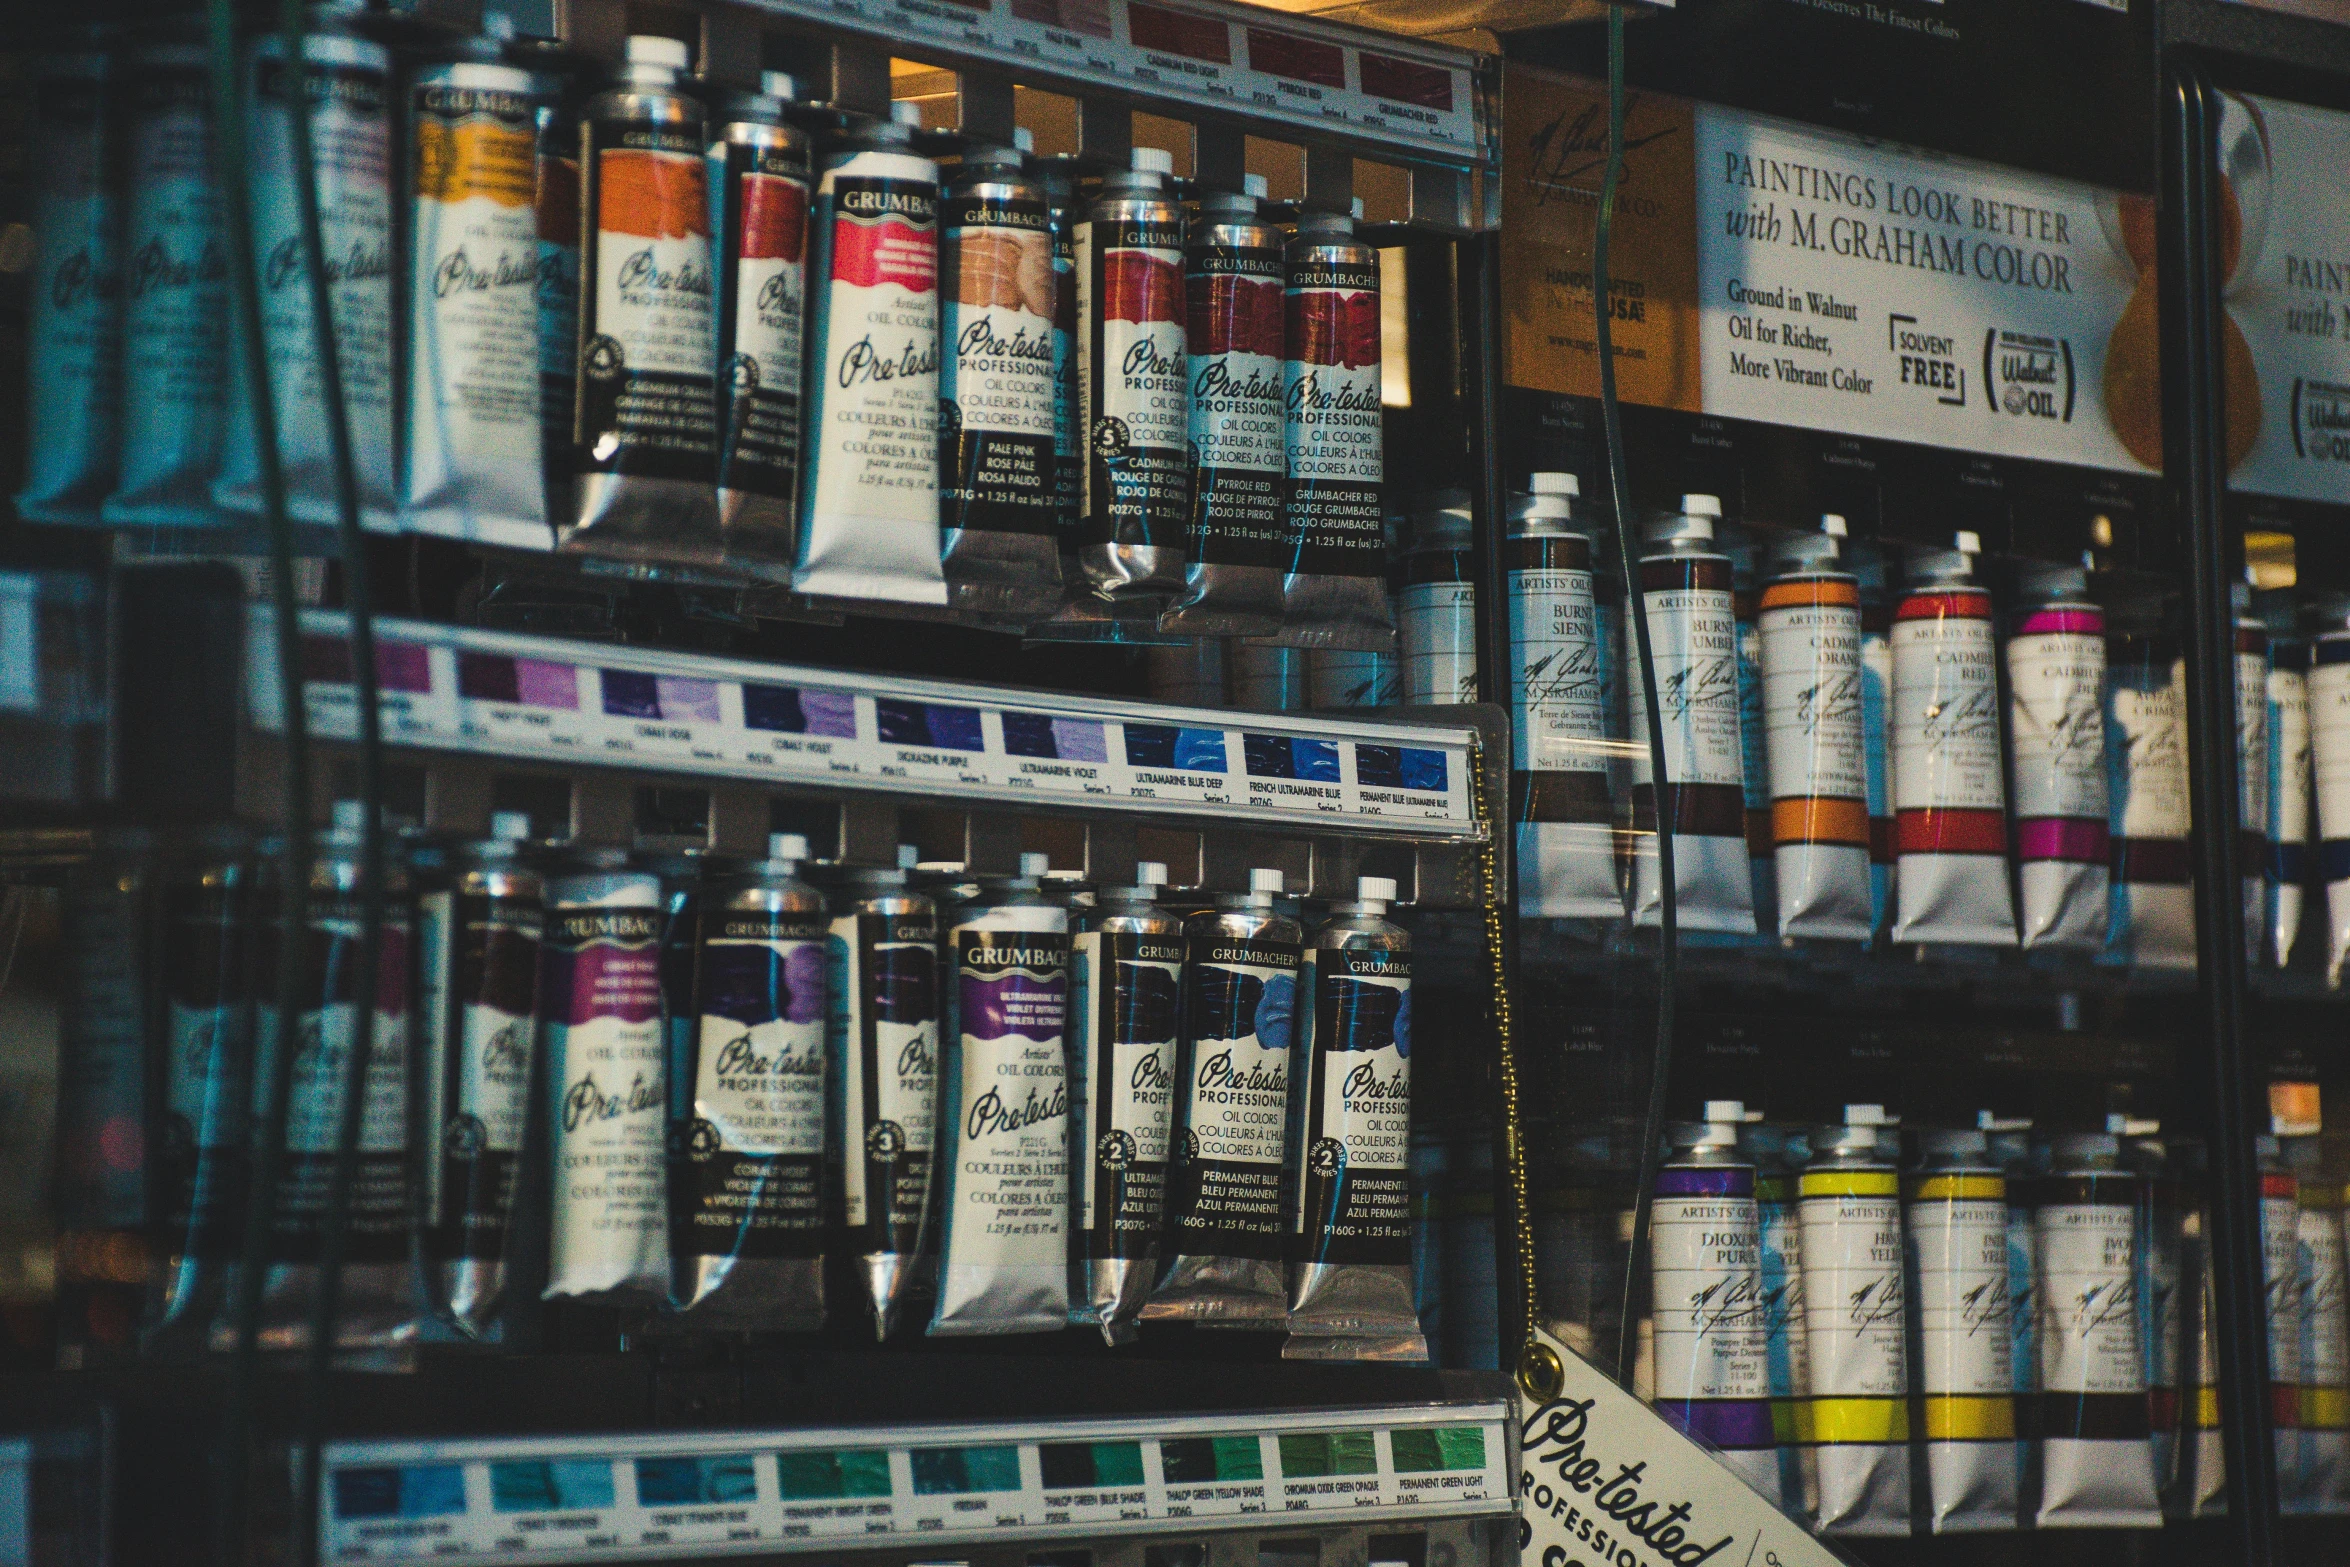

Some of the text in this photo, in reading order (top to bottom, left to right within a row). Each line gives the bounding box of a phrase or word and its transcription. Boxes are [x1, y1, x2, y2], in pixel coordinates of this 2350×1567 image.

[1864, 3, 1885, 24] The
[1924, 17, 1960, 40] Colors
[1725, 151, 2070, 244] PAINTINGS LOOK BETTER
[1725, 202, 1781, 242] with
[1974, 242, 2073, 294] COLOR
[1546, 267, 1646, 298] HANDCAFTED
[1727, 278, 1858, 321] Ground in Walnut
[1729, 315, 1833, 356] Oil for Richer,
[1900, 331, 1954, 355] SOLVENT
[1730, 351, 1873, 394] More Vibrant Color
[1900, 355, 1956, 390] FREE
[2002, 353, 2056, 384] Walnut
[985, 379, 1003, 391] OIL
[1286, 370, 1380, 411] Pre-tested
[2028, 390, 2057, 419] OIL
[1221, 418, 1277, 434] OIL COLORS
[1287, 411, 1380, 428] PROFESSIONAL
[1103, 432, 1114, 445] 5
[1198, 434, 1254, 447] COULEURS
[1312, 430, 1371, 444] OIL COLORS
[988, 443, 1035, 456] PALE PINK
[1289, 445, 1357, 459] COULEURS À
[986, 458, 1012, 469] ROSE
[1203, 450, 1252, 464] COLORES
[1254, 453, 1261, 464] A
[1294, 462, 1381, 476] COLORES A ÓLEO
[978, 472, 1005, 484] ROSA
[1112, 472, 1165, 483] ROUGE DE
[1217, 478, 1271, 491] PYRROLE RED
[1117, 486, 1162, 498] ROJO DE
[1296, 490, 1378, 503] GRUMBACHER RED
[1200, 492, 1280, 507] ROUGE DE PYRROLE
[1208, 506, 1275, 521] ROJO DE PIRROL
[1287, 504, 1381, 516] ROUGE GRUMBACHER
[1290, 517, 1379, 530] ROJO GRUMBACHER
[1516, 577, 1568, 590] ARTISTS'
[1962, 668, 1987, 681] RED
[1538, 709, 1558, 719] Terre
[1560, 709, 1569, 719] de
[1537, 757, 1552, 768] Net
[1555, 758, 1570, 769] 1.25
[1019, 762, 1098, 779] ULTRAMARINE VIOLET
[1136, 772, 1223, 790] ULTRAMARINE BLUE DEEP
[1249, 781, 1341, 800] FRENCH ULTRAMARINE BLUE
[1359, 790, 1391, 804] PERMANENT
[1391, 794, 1405, 805] BLUE
[997, 1063, 1020, 1076] OIL
[1223, 1111, 1278, 1125] OIL COLORS
[1198, 1125, 1264, 1140] COULEURS À
[879, 1133, 892, 1150] 3
[1110, 1143, 1123, 1159] 2
[1320, 1150, 1332, 1165] 2
[1351, 1151, 1396, 1163] COLORES
[1101, 1160, 1128, 1171] SERIES
[1313, 1165, 1338, 1177] SERIES
[1203, 1171, 1278, 1185] PERMANENT BLUE
[1127, 1187, 1149, 1198] BLEU
[1201, 1185, 1278, 1199] BLEU PERMANENT
[1351, 1194, 1370, 1203] BLEU
[1121, 1201, 1145, 1212] AZUL
[1196, 1199, 1278, 1214] AZUL PERMANENTE
[1347, 1207, 1369, 1218] AZUL
[1681, 1206, 1736, 1219] ARTISTS'
[1115, 1220, 1145, 1231] P307G
[1218, 1219, 1236, 1230] 1.25
[1247, 1222, 1257, 1231] oz
[1324, 1226, 1355, 1235] P160G
[1366, 1227, 1383, 1236] 1.25
[1392, 1229, 1401, 1237] oz
[1717, 1385, 1734, 1396] 1.25
[1284, 1480, 1379, 1497] CHROMIUM OXIDE GREEN OPAQUE
[1399, 1475, 1484, 1490] PERMANENT GREEN LIGHT
[1521, 1397, 1734, 1567] Pre-tested
[1192, 1485, 1265, 1500] GREEN (YELLOW SHADE)
